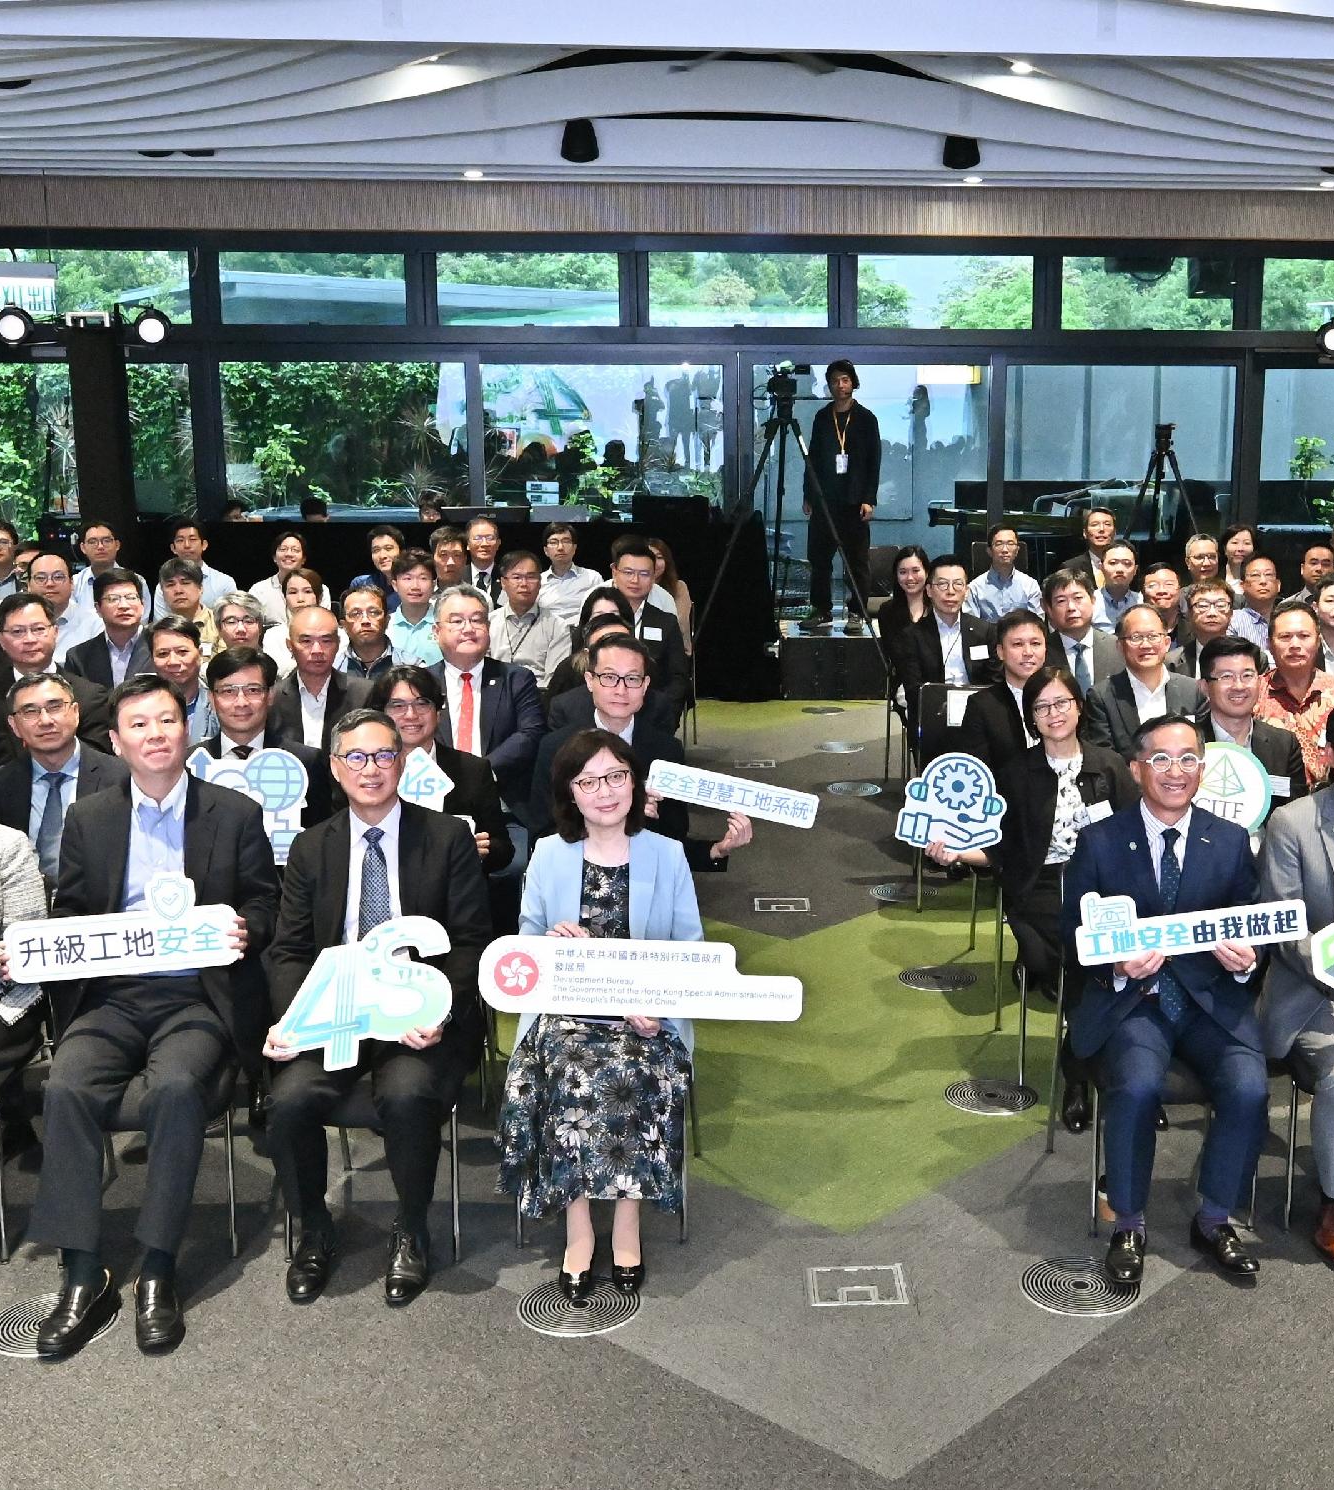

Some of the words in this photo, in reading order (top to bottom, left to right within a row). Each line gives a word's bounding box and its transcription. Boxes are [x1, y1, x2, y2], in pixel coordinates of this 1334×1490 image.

[28, 285, 55, 311] 出口
[656, 771, 810, 820] 安全智慧工地系統
[19, 922, 223, 967] 升級工地安全
[1084, 909, 1299, 957] 工地安全由我做起
[554, 962, 585, 972] 發展局
[553, 975, 605, 986] Development
[606, 976, 635, 986] Bureau
[553, 985, 568, 993] The
[569, 985, 617, 994] Government
[626, 987, 639, 995] the
[641, 987, 661, 997] Hong
[663, 988, 683, 998] Kong
[684, 988, 713, 999] Special
[714, 990, 768, 1000] Administrative
[768, 991, 795, 1001] Region
[271, 917, 452, 1071] 4S
[609, 996, 643, 1006] Republic
[644, 997, 653, 1005] of
[654, 998, 677, 1006] China
